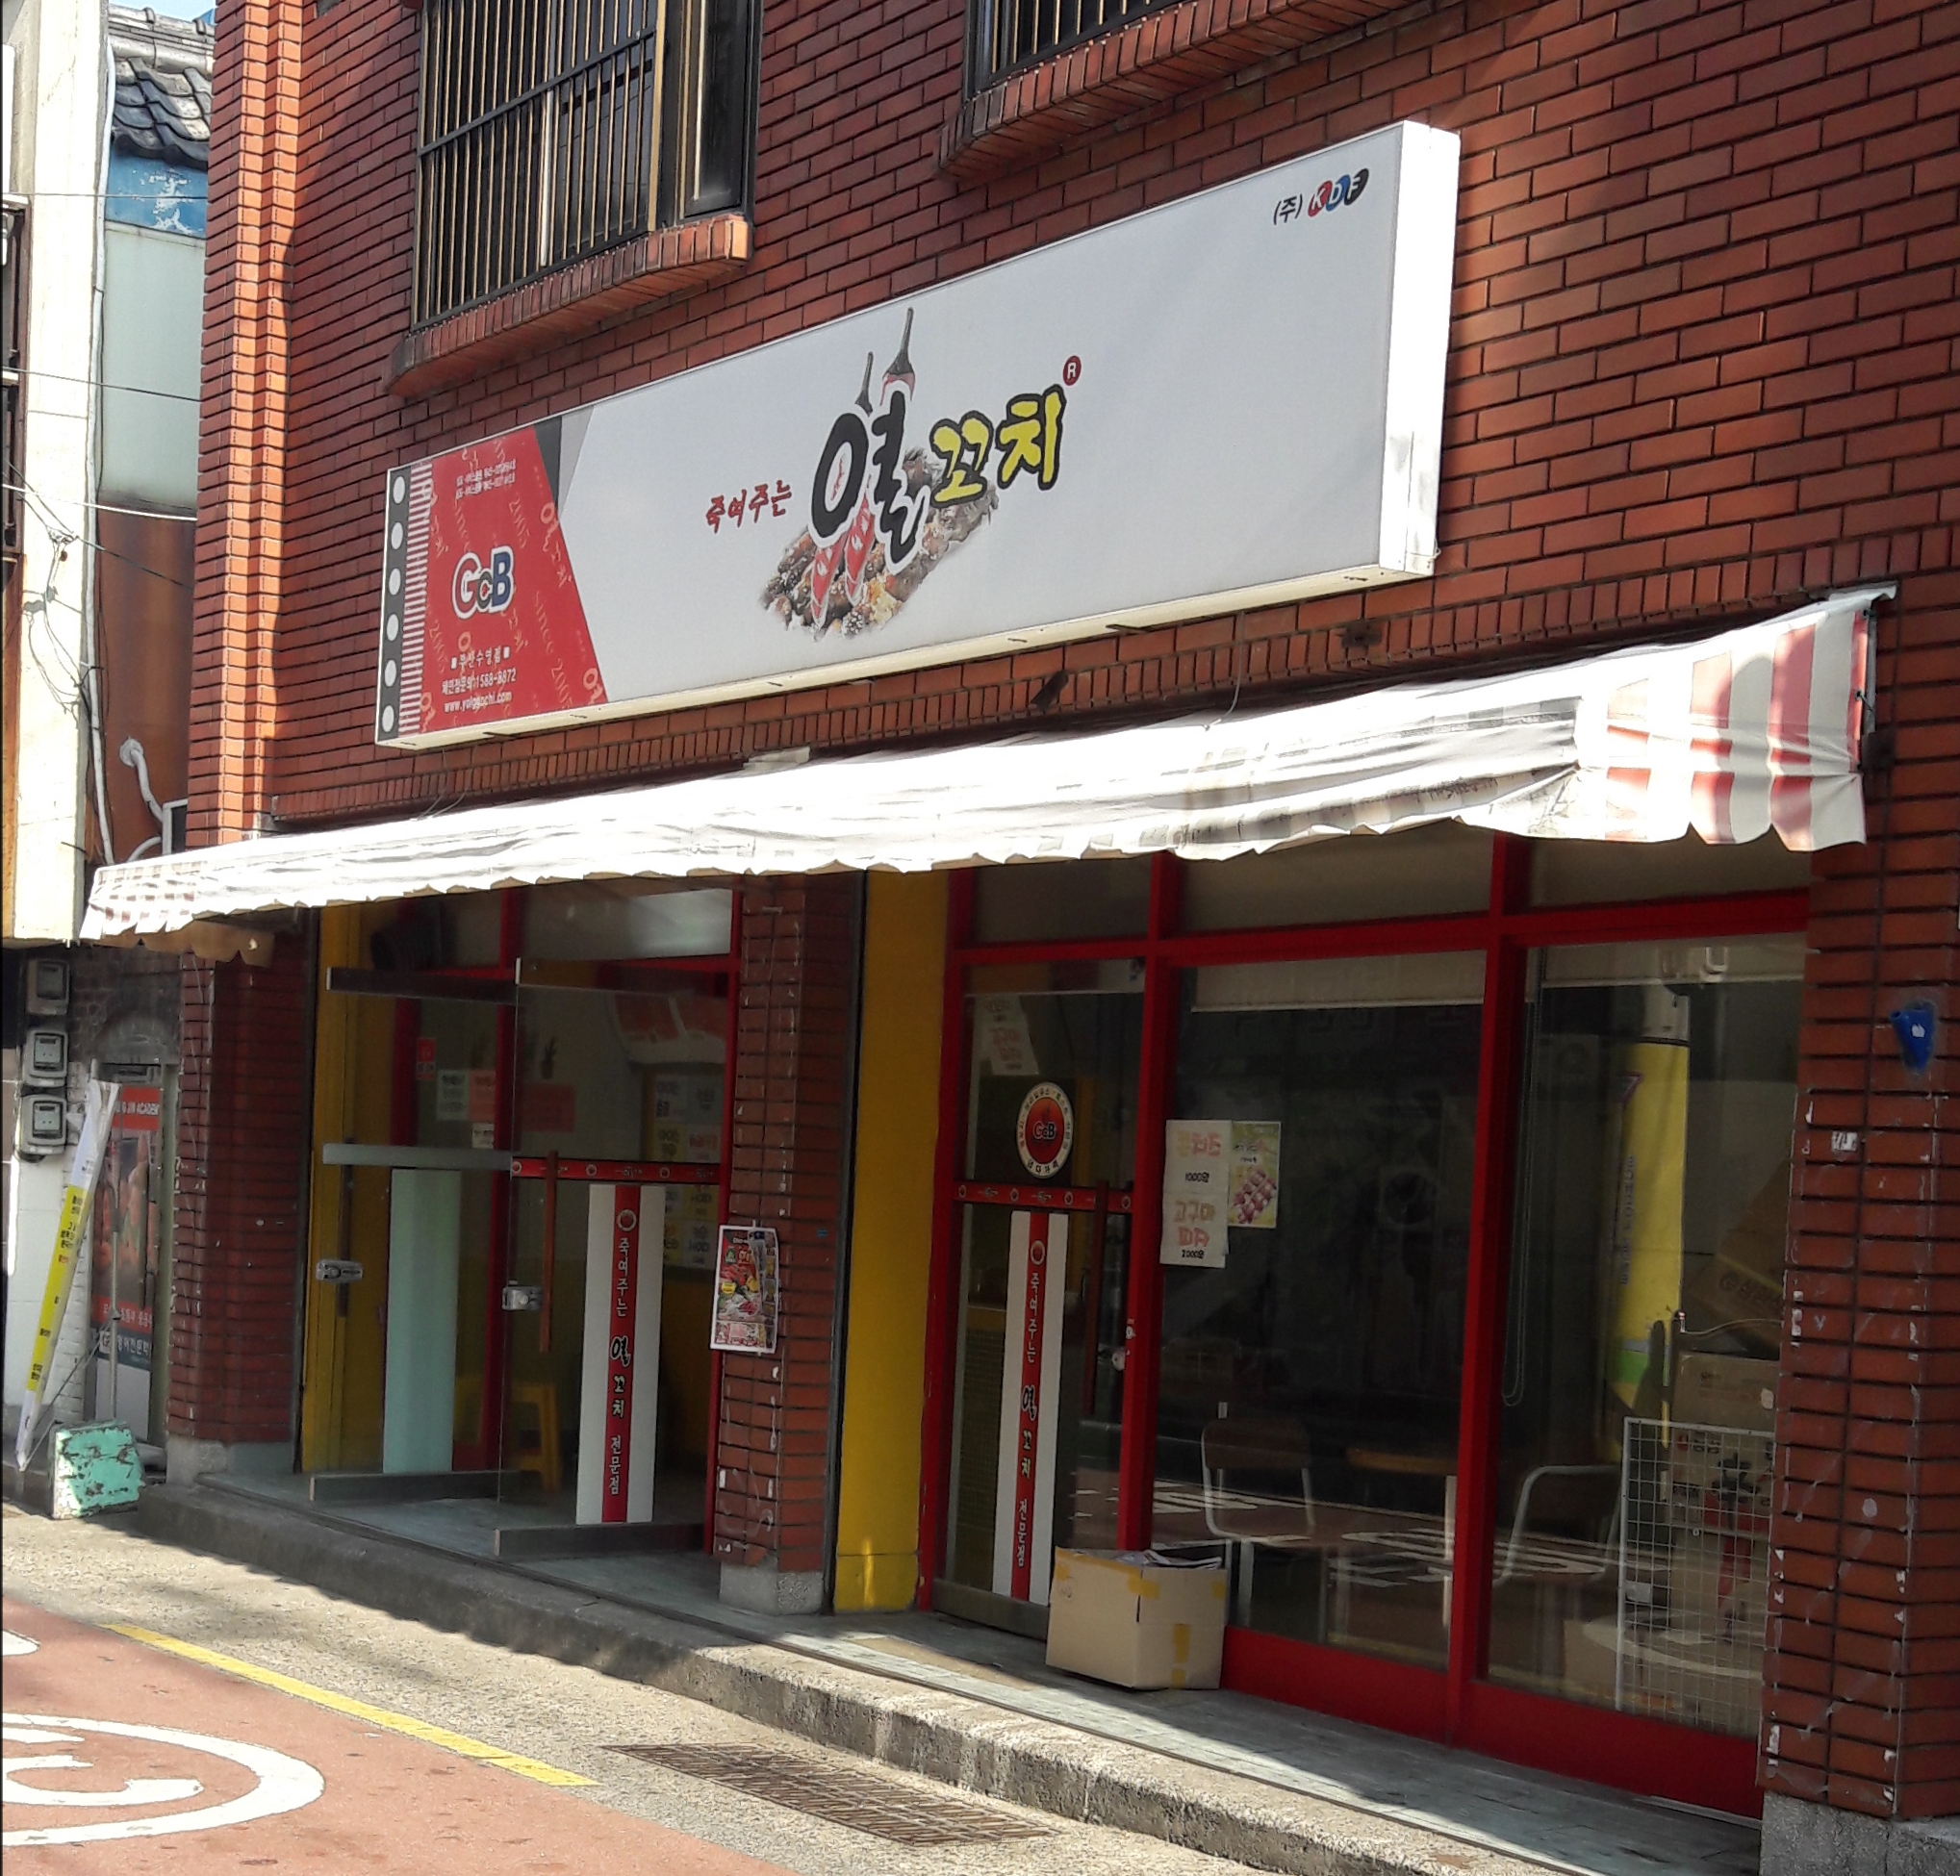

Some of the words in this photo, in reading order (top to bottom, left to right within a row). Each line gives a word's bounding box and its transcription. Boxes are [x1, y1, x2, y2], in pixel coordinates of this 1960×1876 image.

[1273, 193, 1303, 226] (주)
[705, 480, 792, 533] 죽여주는
[811, 384, 1068, 566] 열꼬치
[616, 1235, 631, 1318] 죽여주는
[1026, 1271, 1040, 1364] 죽여주는
[608, 1433, 622, 1496] 전문점
